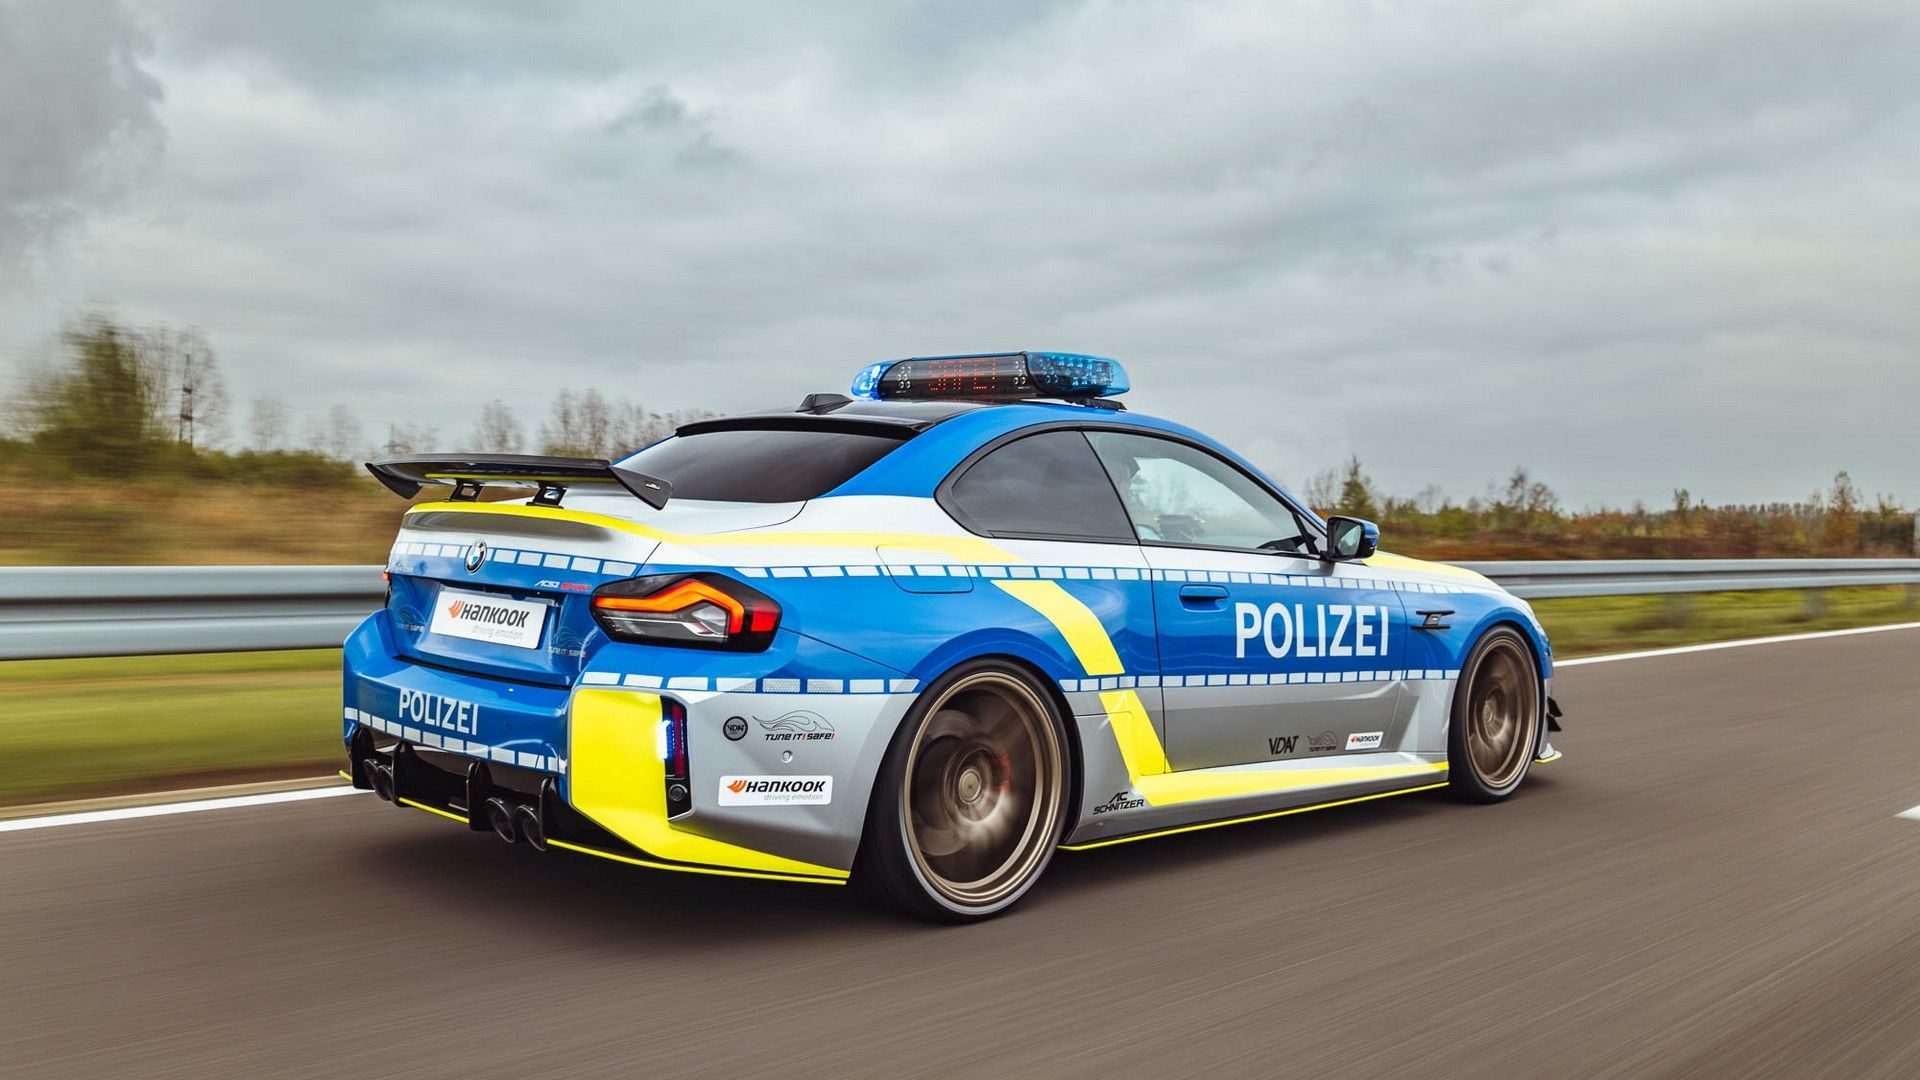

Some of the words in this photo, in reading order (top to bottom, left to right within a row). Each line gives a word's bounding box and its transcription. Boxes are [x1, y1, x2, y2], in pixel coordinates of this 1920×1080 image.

[1235, 602, 1389, 659] POLIZEI
[399, 688, 479, 736] POLIZEI
[763, 793, 791, 803] driving
[791, 793, 824, 801] emotion
[1108, 791, 1128, 804] AC
[1093, 798, 1144, 815] SCHNITZER
